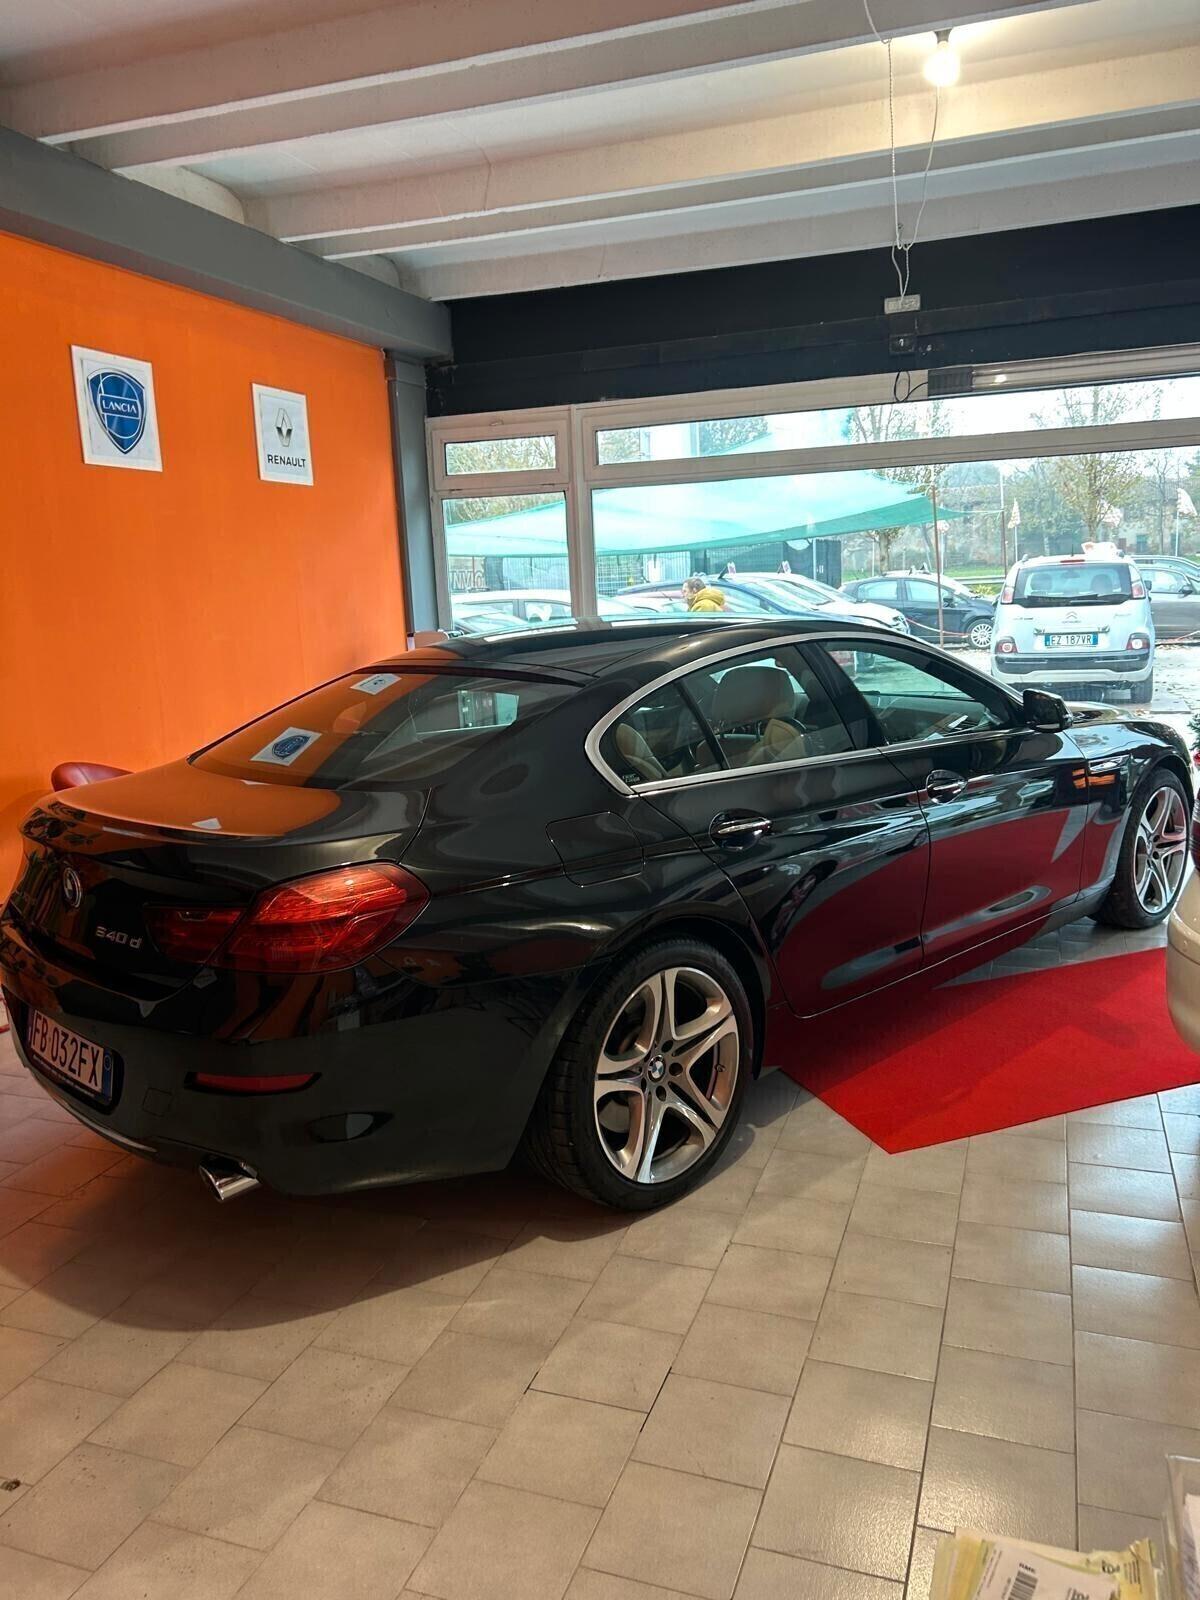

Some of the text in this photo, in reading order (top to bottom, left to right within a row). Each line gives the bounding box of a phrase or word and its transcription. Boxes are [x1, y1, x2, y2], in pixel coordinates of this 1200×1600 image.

[102, 399, 137, 414] LANCIA
[267, 454, 307, 469] RENAULT
[1066, 634, 1092, 645] 187VR
[51, 1026, 100, 1087] 032FX
